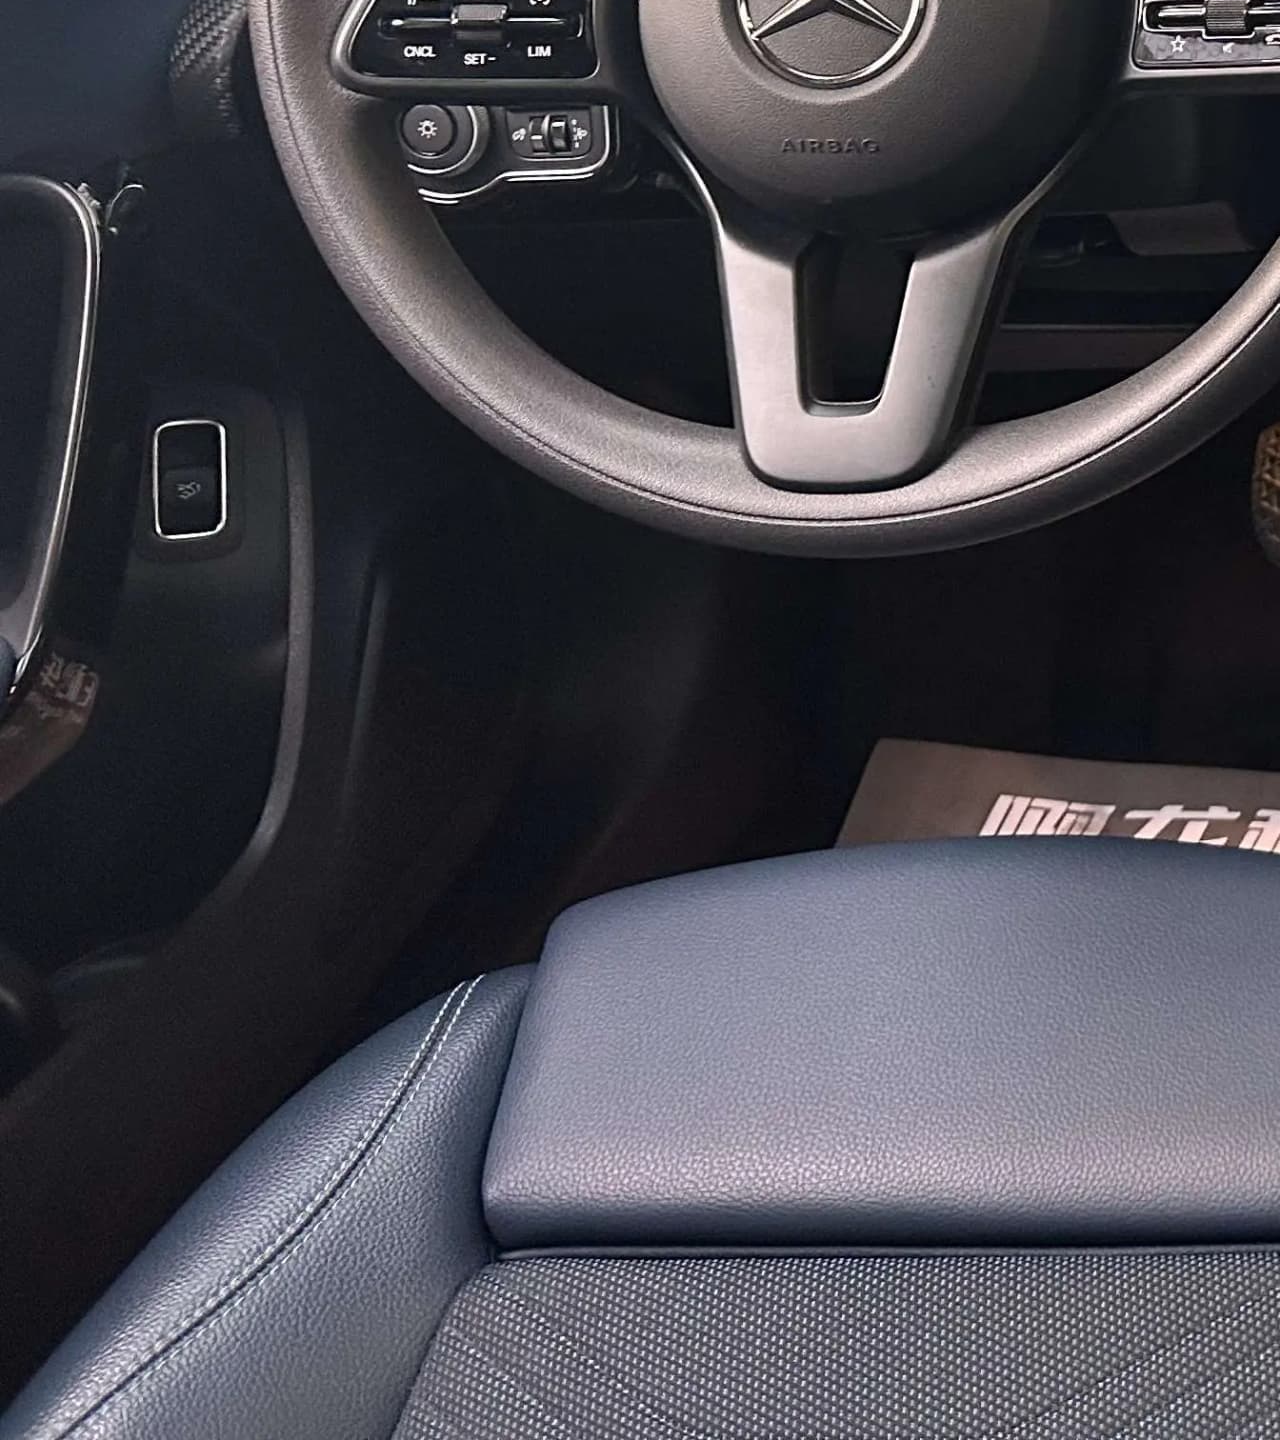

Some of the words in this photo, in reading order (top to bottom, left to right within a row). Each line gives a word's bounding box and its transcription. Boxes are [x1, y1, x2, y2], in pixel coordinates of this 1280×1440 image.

[403, 46, 436, 58] CNCL
[527, 46, 552, 57] LIM
[780, 137, 881, 155] AIRBAG
